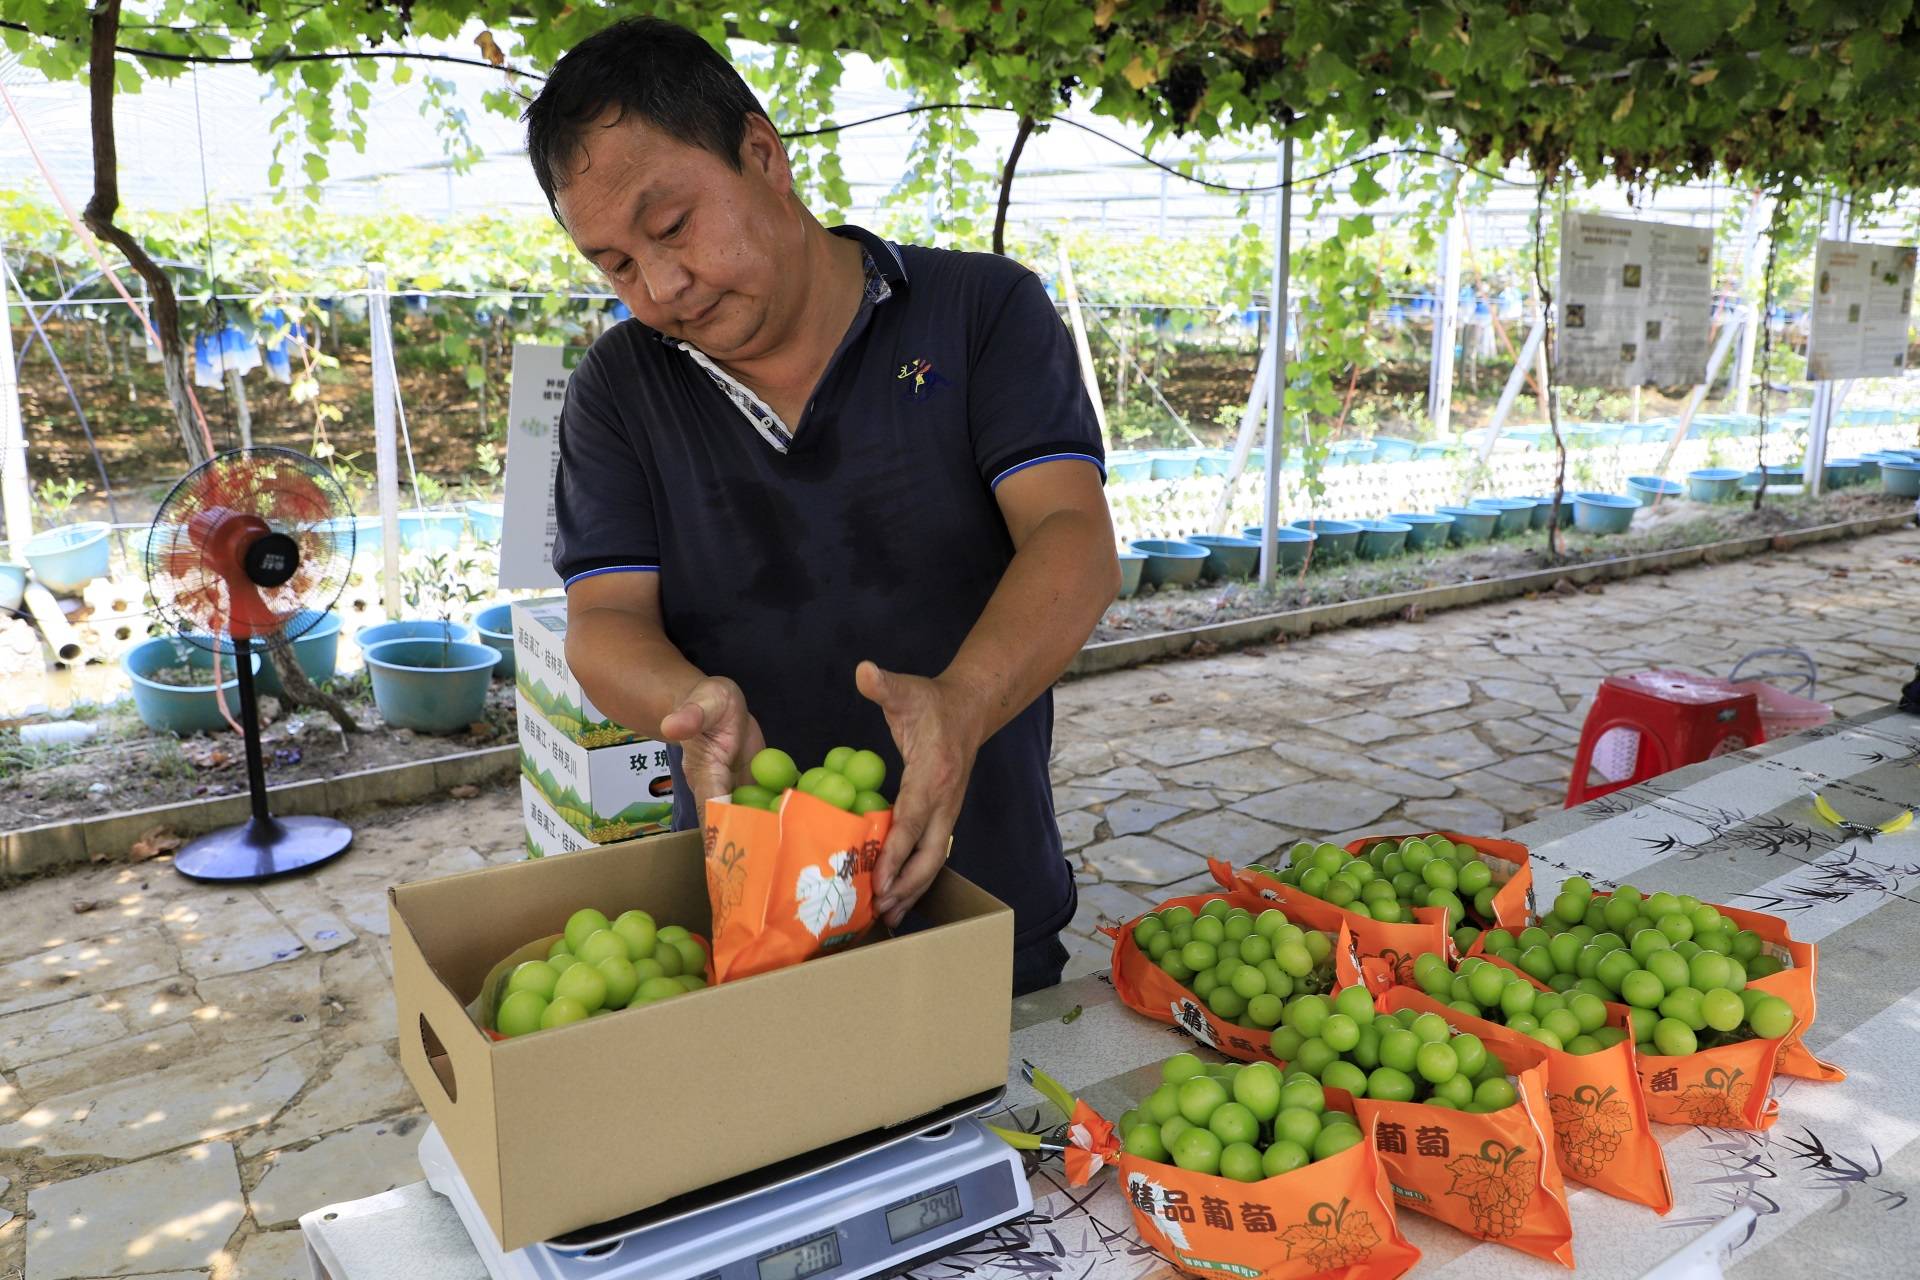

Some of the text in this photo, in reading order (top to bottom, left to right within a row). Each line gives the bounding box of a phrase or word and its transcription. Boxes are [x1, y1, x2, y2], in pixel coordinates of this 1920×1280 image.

[530, 801, 583, 852] 源自漓江·桂林
[1376, 1121, 1451, 1158] 葡萄
[1129, 1181, 1278, 1234] 精品葡萄
